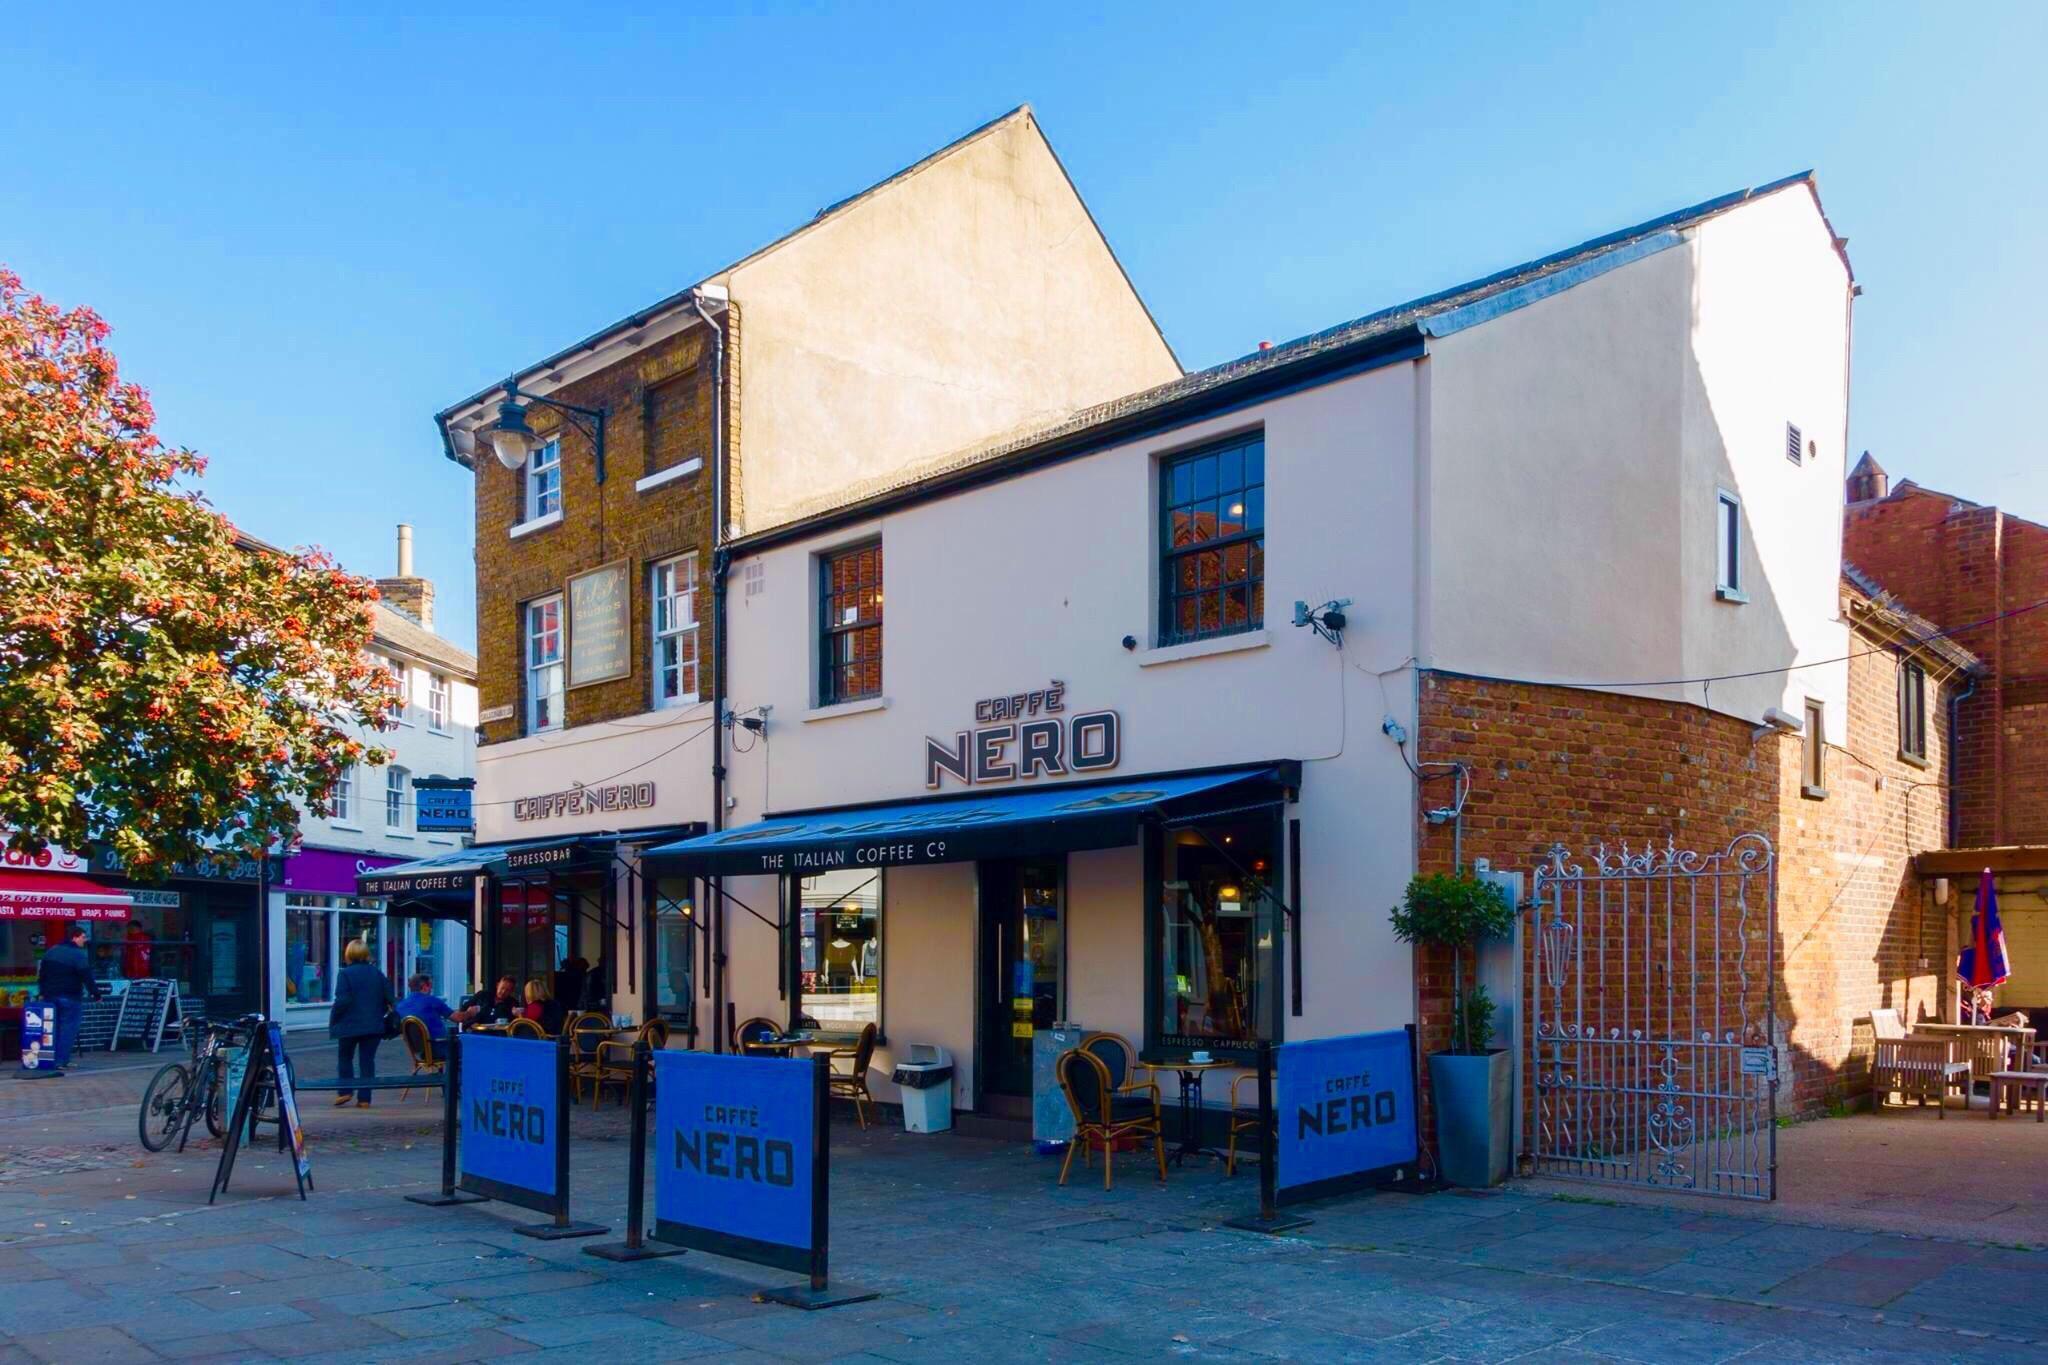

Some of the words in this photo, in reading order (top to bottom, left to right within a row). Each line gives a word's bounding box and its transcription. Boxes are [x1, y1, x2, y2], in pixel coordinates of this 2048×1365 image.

[975, 680, 1065, 722] CAFFÈ
[925, 710, 1121, 789] NERO
[419, 807, 470, 819] NERO
[514, 781, 585, 822] CAFFÈ
[585, 781, 655, 815] NERO
[508, 850, 550, 868] ESPRESSO
[552, 848, 571, 862] BAR
[761, 854, 783, 868] THE
[794, 850, 845, 866] ITALIAN
[855, 844, 914, 863] COFFEE
[366, 882, 378, 893] THE
[383, 880, 410, 891] ITALIAN
[415, 876, 447, 889] COFFEE
[21, 907, 44, 915] JACKET
[45, 907, 76, 917] POTATOES
[1161, 1036, 1204, 1047] ESPRESSO
[490, 1075, 524, 1096] CAFFÈ
[1326, 1071, 1371, 1093] CAFFÈ
[473, 1100, 545, 1146] NERO
[705, 1104, 760, 1128] CAFFÈ
[1298, 1091, 1395, 1141] NERO
[675, 1129, 794, 1188] NERO
